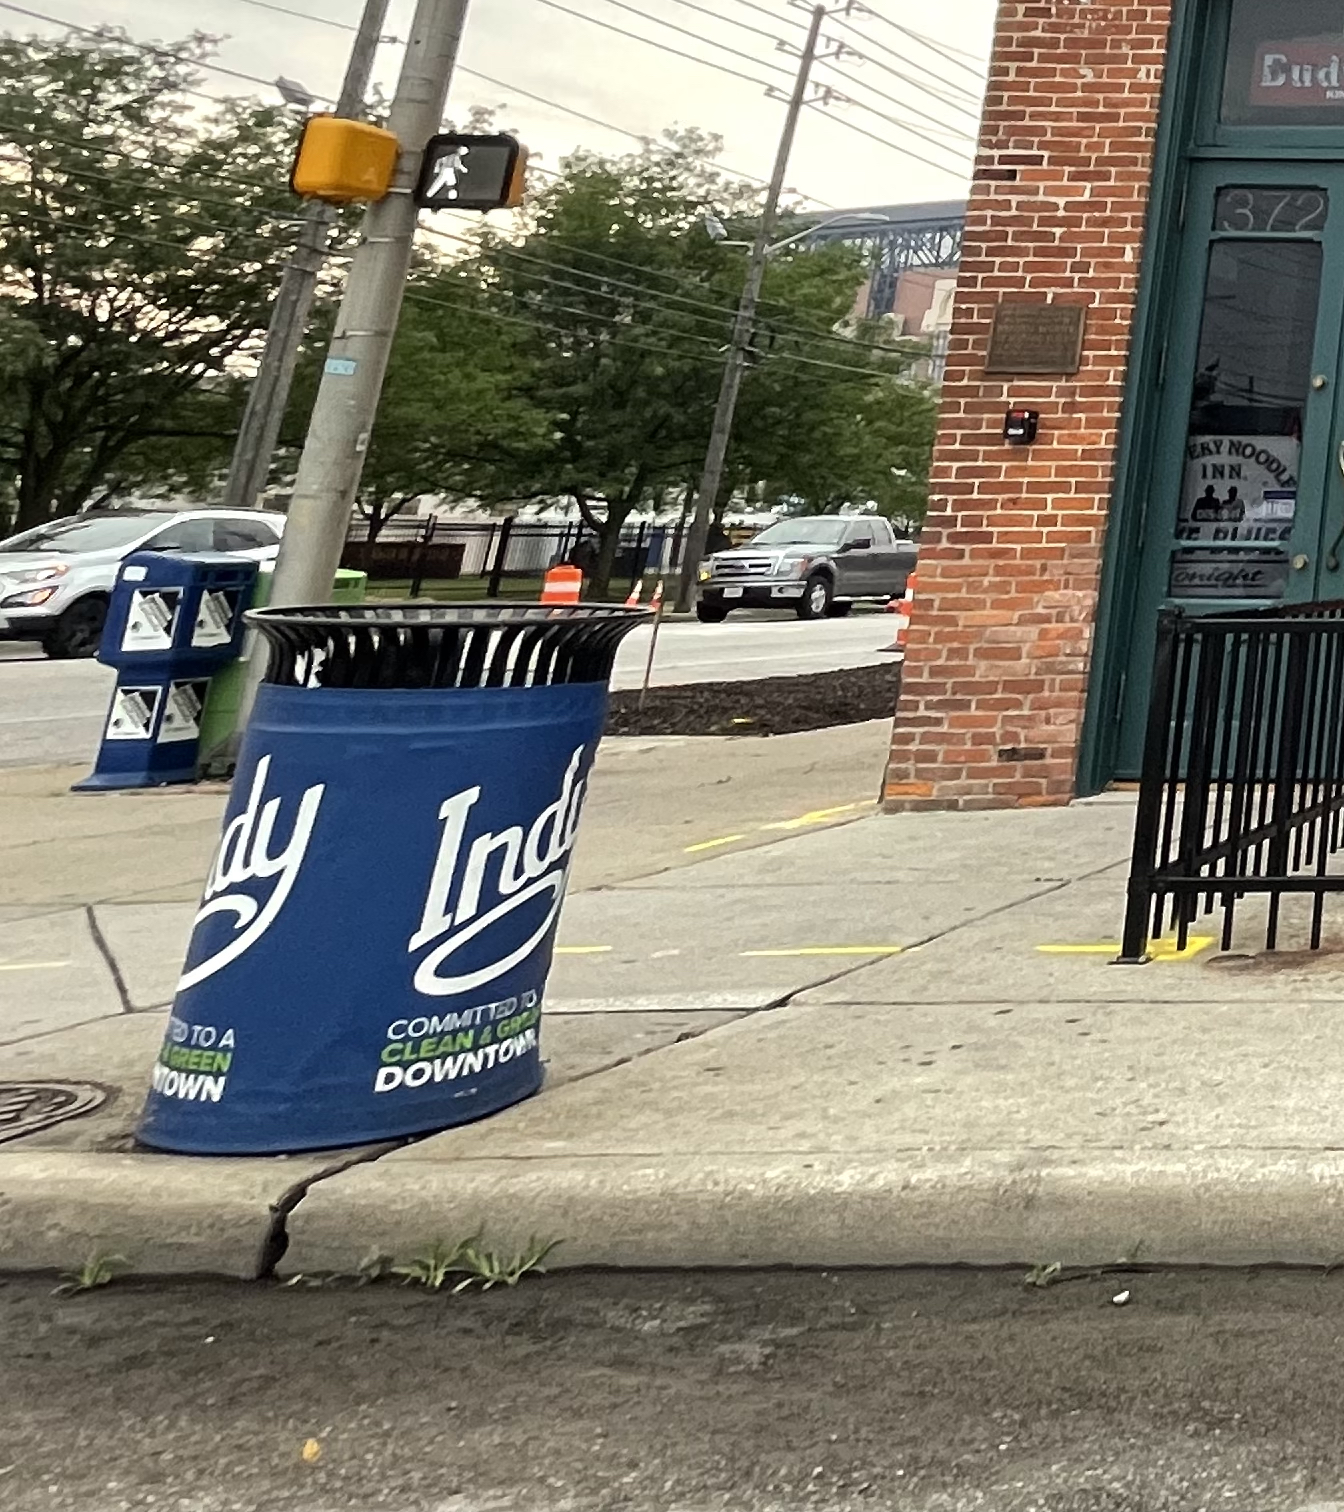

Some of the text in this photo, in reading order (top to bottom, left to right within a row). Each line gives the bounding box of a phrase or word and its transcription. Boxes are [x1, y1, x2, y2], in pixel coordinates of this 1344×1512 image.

[1223, 189, 1325, 232] 372
[1201, 463, 1243, 480] INN
[1228, 439, 1298, 488] NOODLE
[176, 753, 325, 992] dy
[190, 1024, 217, 1048] TO
[218, 1028, 235, 1048] A
[386, 997, 518, 1040] COMMITTED
[381, 1029, 474, 1064] CLEAN
